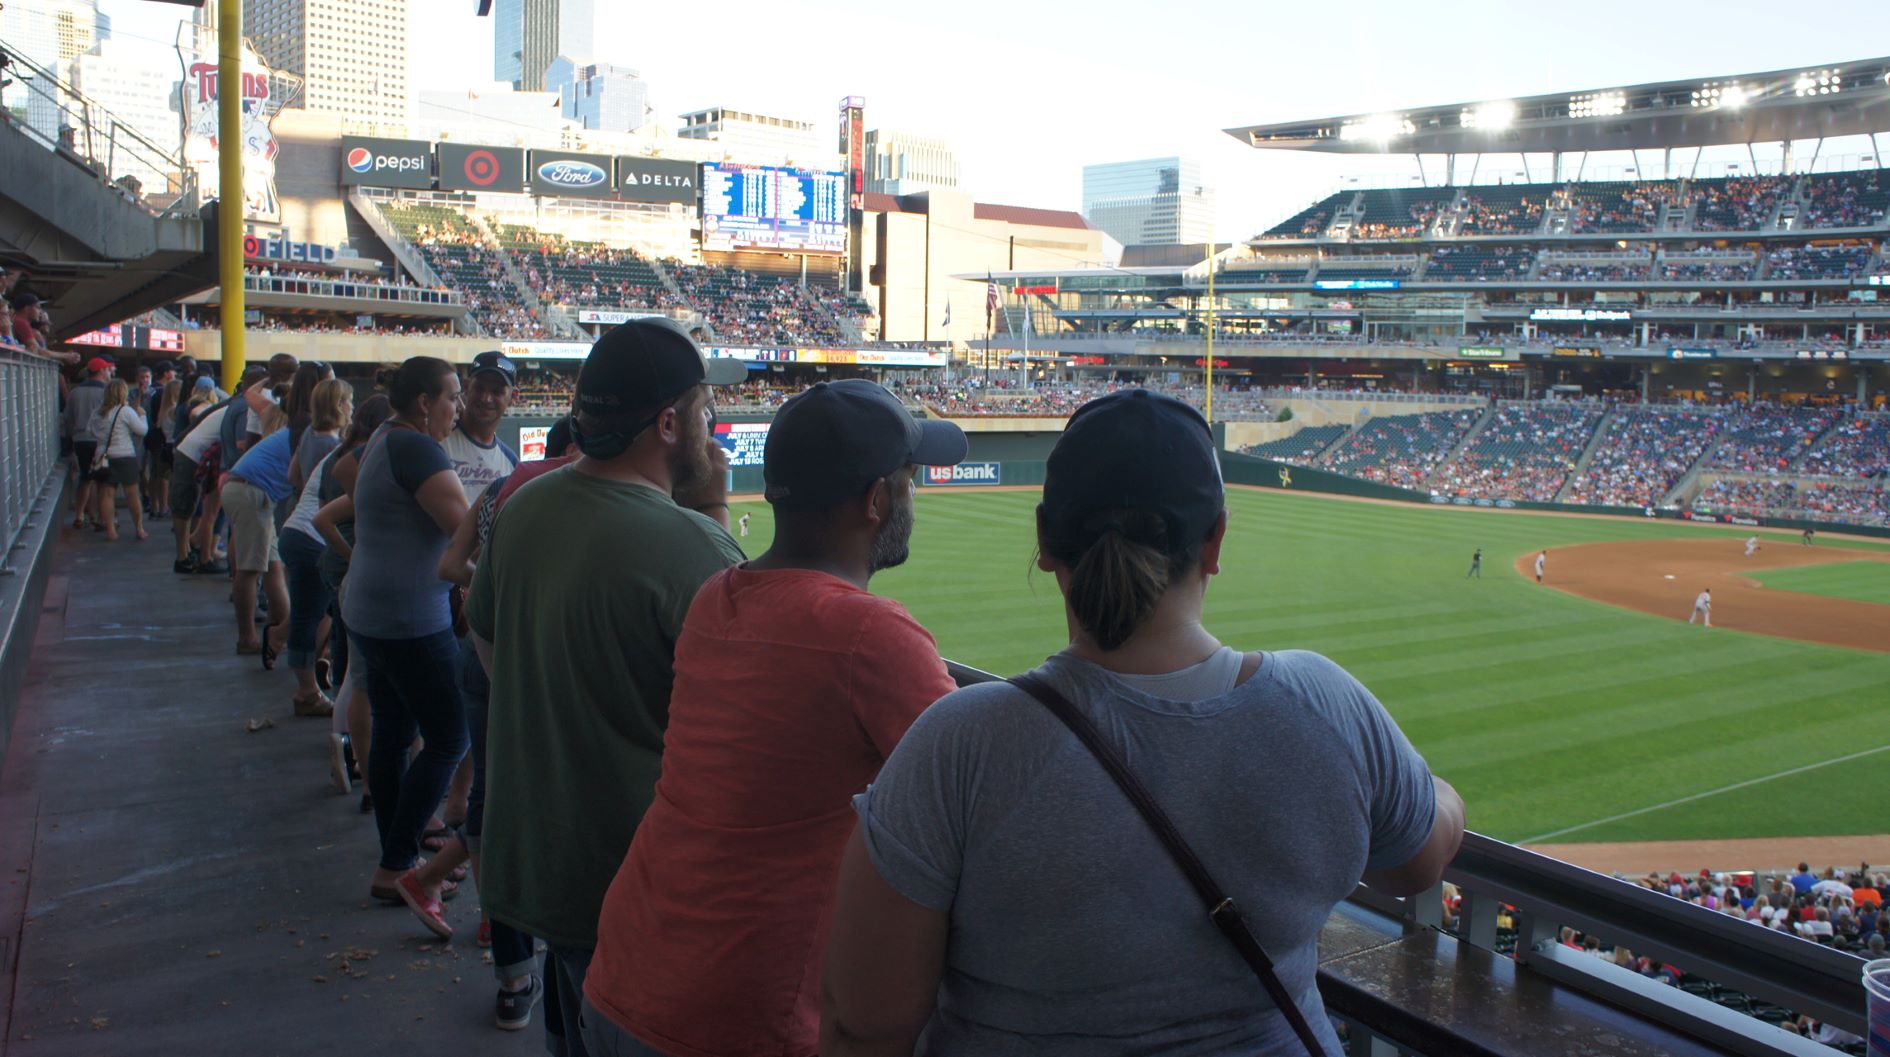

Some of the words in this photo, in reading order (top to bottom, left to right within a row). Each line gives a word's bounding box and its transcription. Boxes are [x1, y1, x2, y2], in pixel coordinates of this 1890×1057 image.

[190, 62, 270, 103] Tns
[375, 154, 425, 173] pepsi
[551, 165, 593, 185] Ford
[642, 173, 692, 188] DELTA
[265, 238, 336, 263] FIELD
[603, 313, 650, 322] SUPERAM
[522, 431, 535, 441] Old
